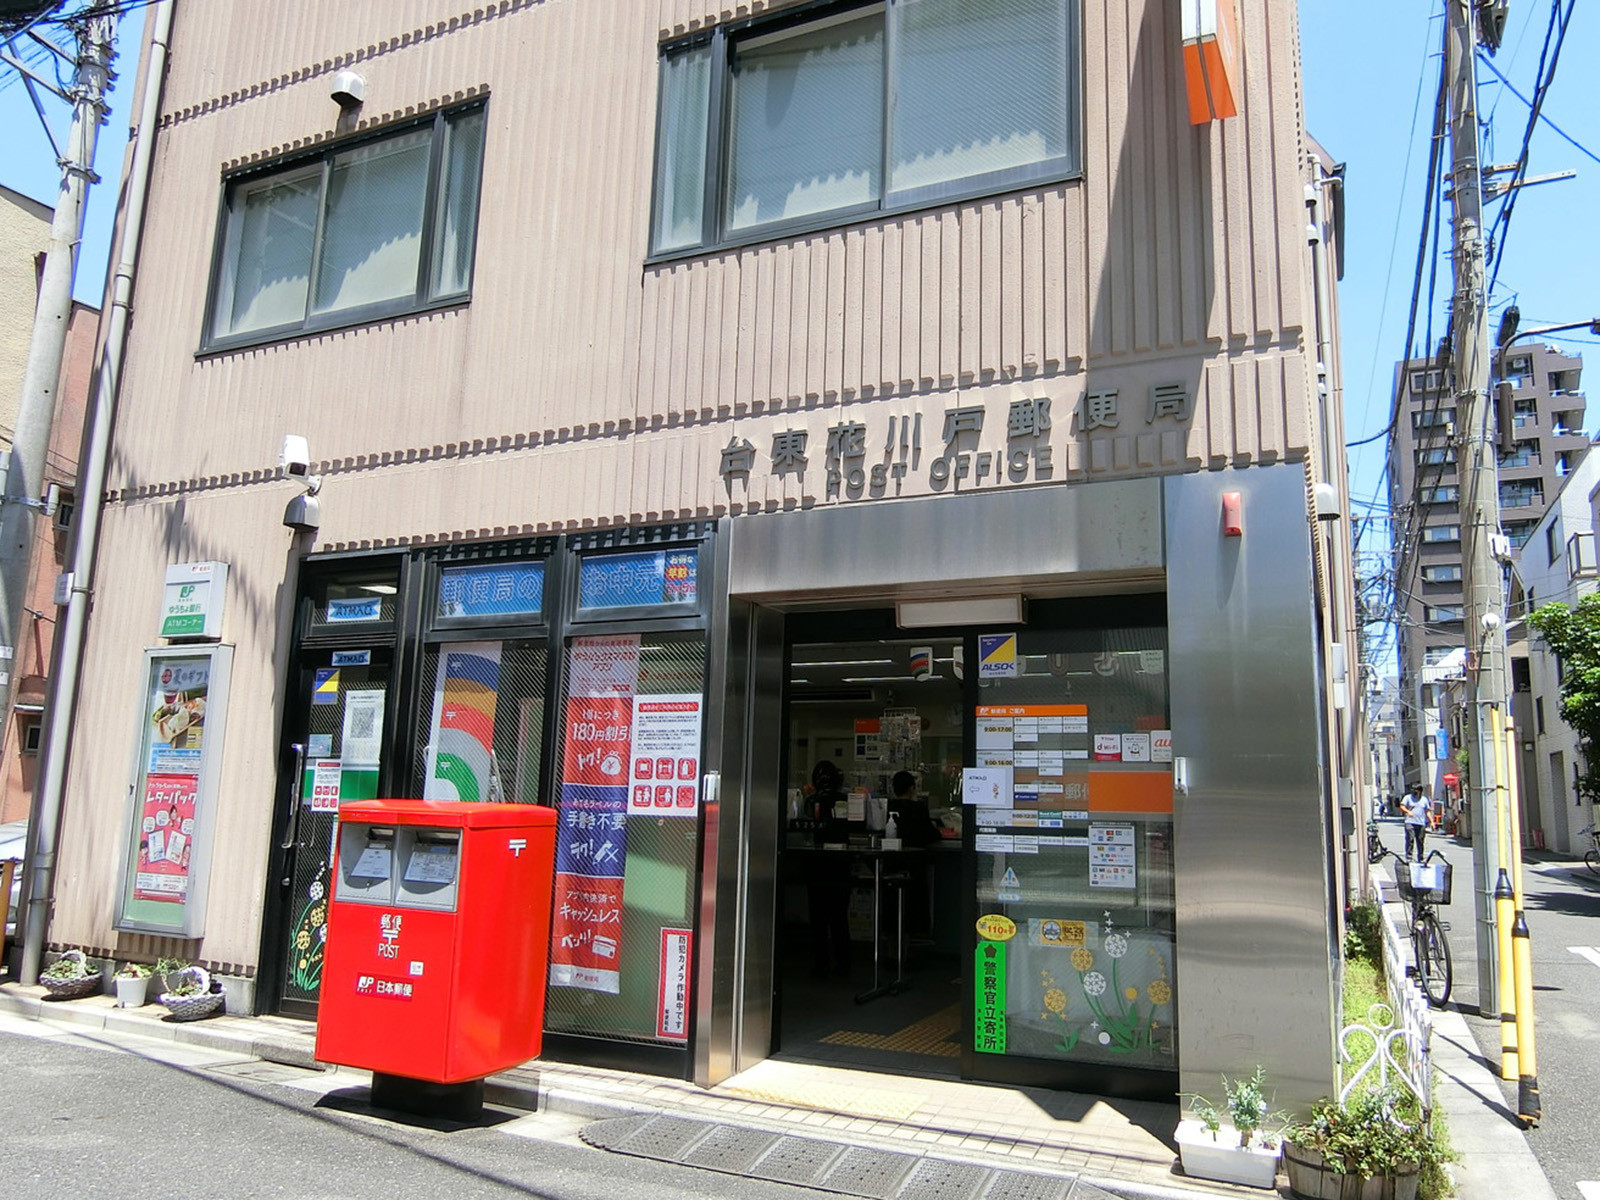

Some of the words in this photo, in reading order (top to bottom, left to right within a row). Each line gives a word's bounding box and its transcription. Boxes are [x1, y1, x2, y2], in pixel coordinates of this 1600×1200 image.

[721, 383, 1191, 473] 台東花川戸郵便局
[826, 462, 908, 492] POST
[931, 446, 1054, 482] OFFICE
[443, 573, 541, 606] 郵便局の
[584, 564, 660, 596] お中元
[169, 604, 201, 613] ゆうちょ銀行
[168, 619, 203, 628] ATMコーナー
[981, 662, 1014, 671] ALSOK
[573, 722, 632, 742] 180円割引
[146, 791, 197, 805] レターパック
[567, 810, 626, 830] 手書き不要
[380, 914, 402, 931] 郵便
[559, 902, 621, 924] キャッシュレス
[378, 943, 399, 958] POST
[376, 981, 412, 997] 日本郵便
[675, 935, 686, 1029] 防犯カメラ作動中です
[983, 961, 997, 1050] 警察官立寄所
